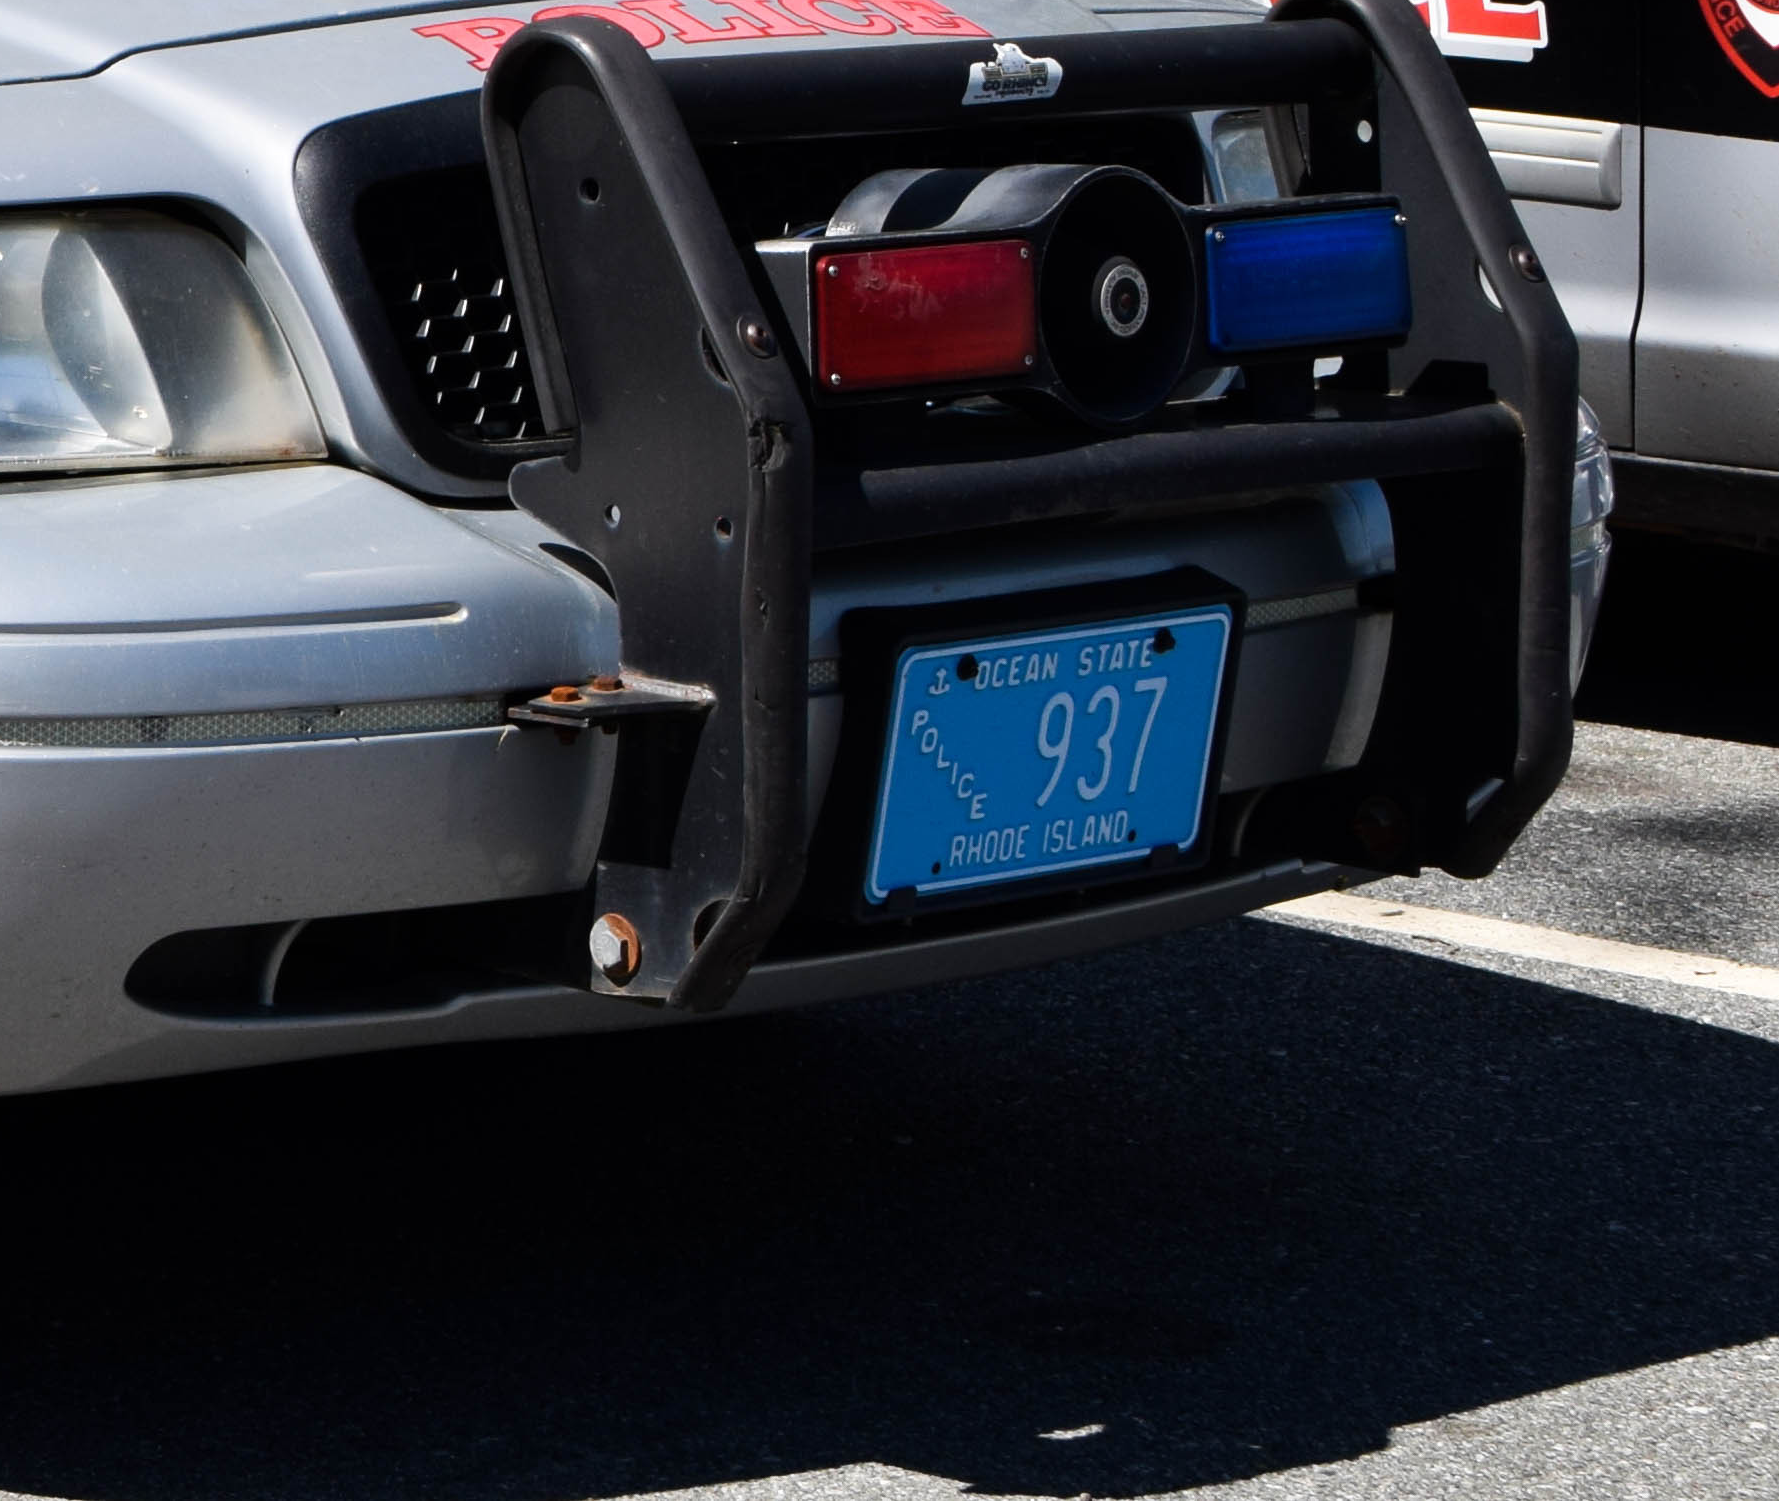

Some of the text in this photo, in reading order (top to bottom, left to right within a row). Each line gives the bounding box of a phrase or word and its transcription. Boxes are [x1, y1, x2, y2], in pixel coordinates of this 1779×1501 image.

[974, 637, 1156, 691] OCEAN STATE
[911, 709, 988, 822] POLICE
[1035, 676, 1168, 809] 937
[948, 810, 1129, 869] RHODE ISLAND
